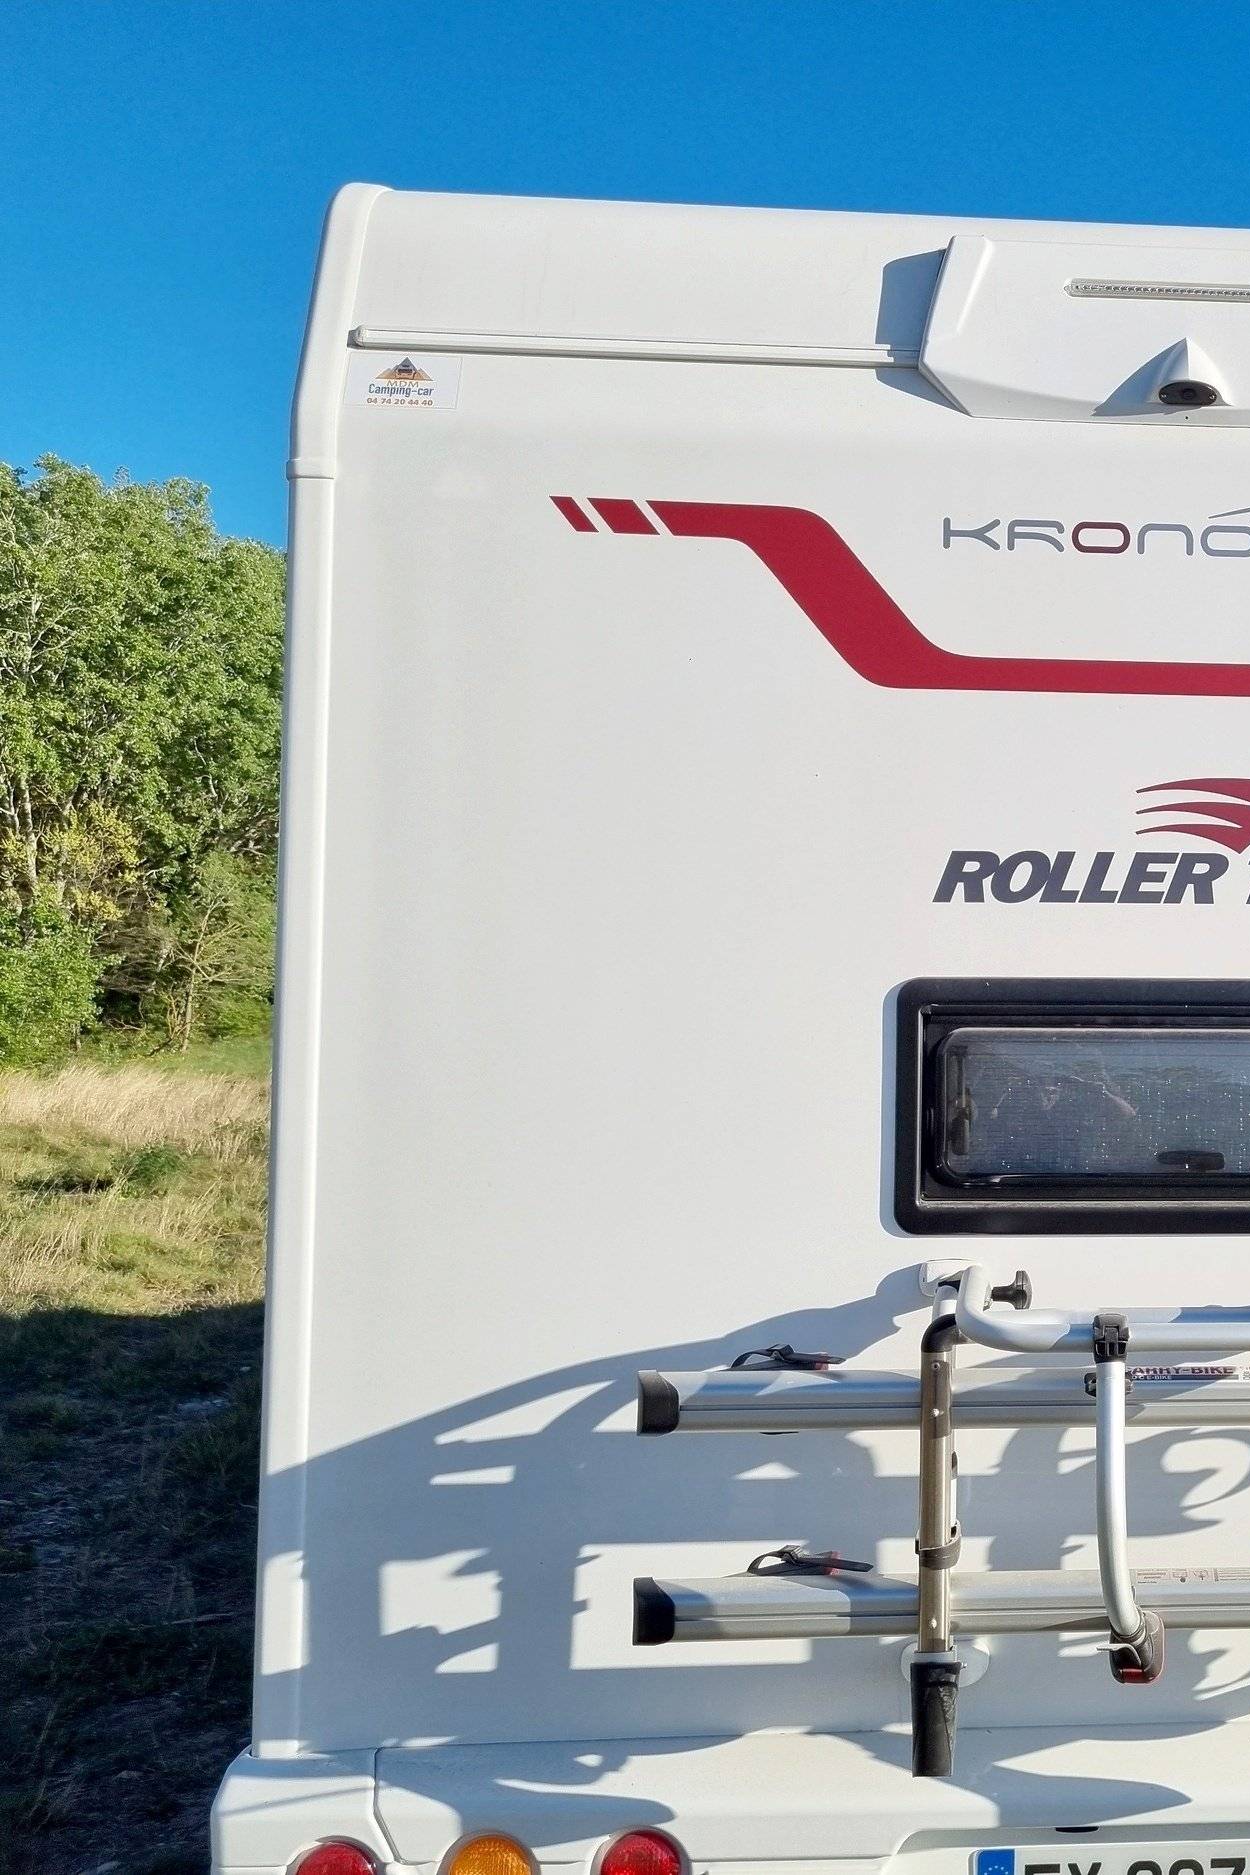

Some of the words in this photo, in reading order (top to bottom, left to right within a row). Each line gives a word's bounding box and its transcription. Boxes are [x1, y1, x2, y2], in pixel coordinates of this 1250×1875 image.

[386, 380, 419, 388] MDM
[368, 383, 434, 398] Camping-car
[932, 850, 1230, 904] ROLLER
[1128, 1366, 1234, 1375] ARRY-BIKE
